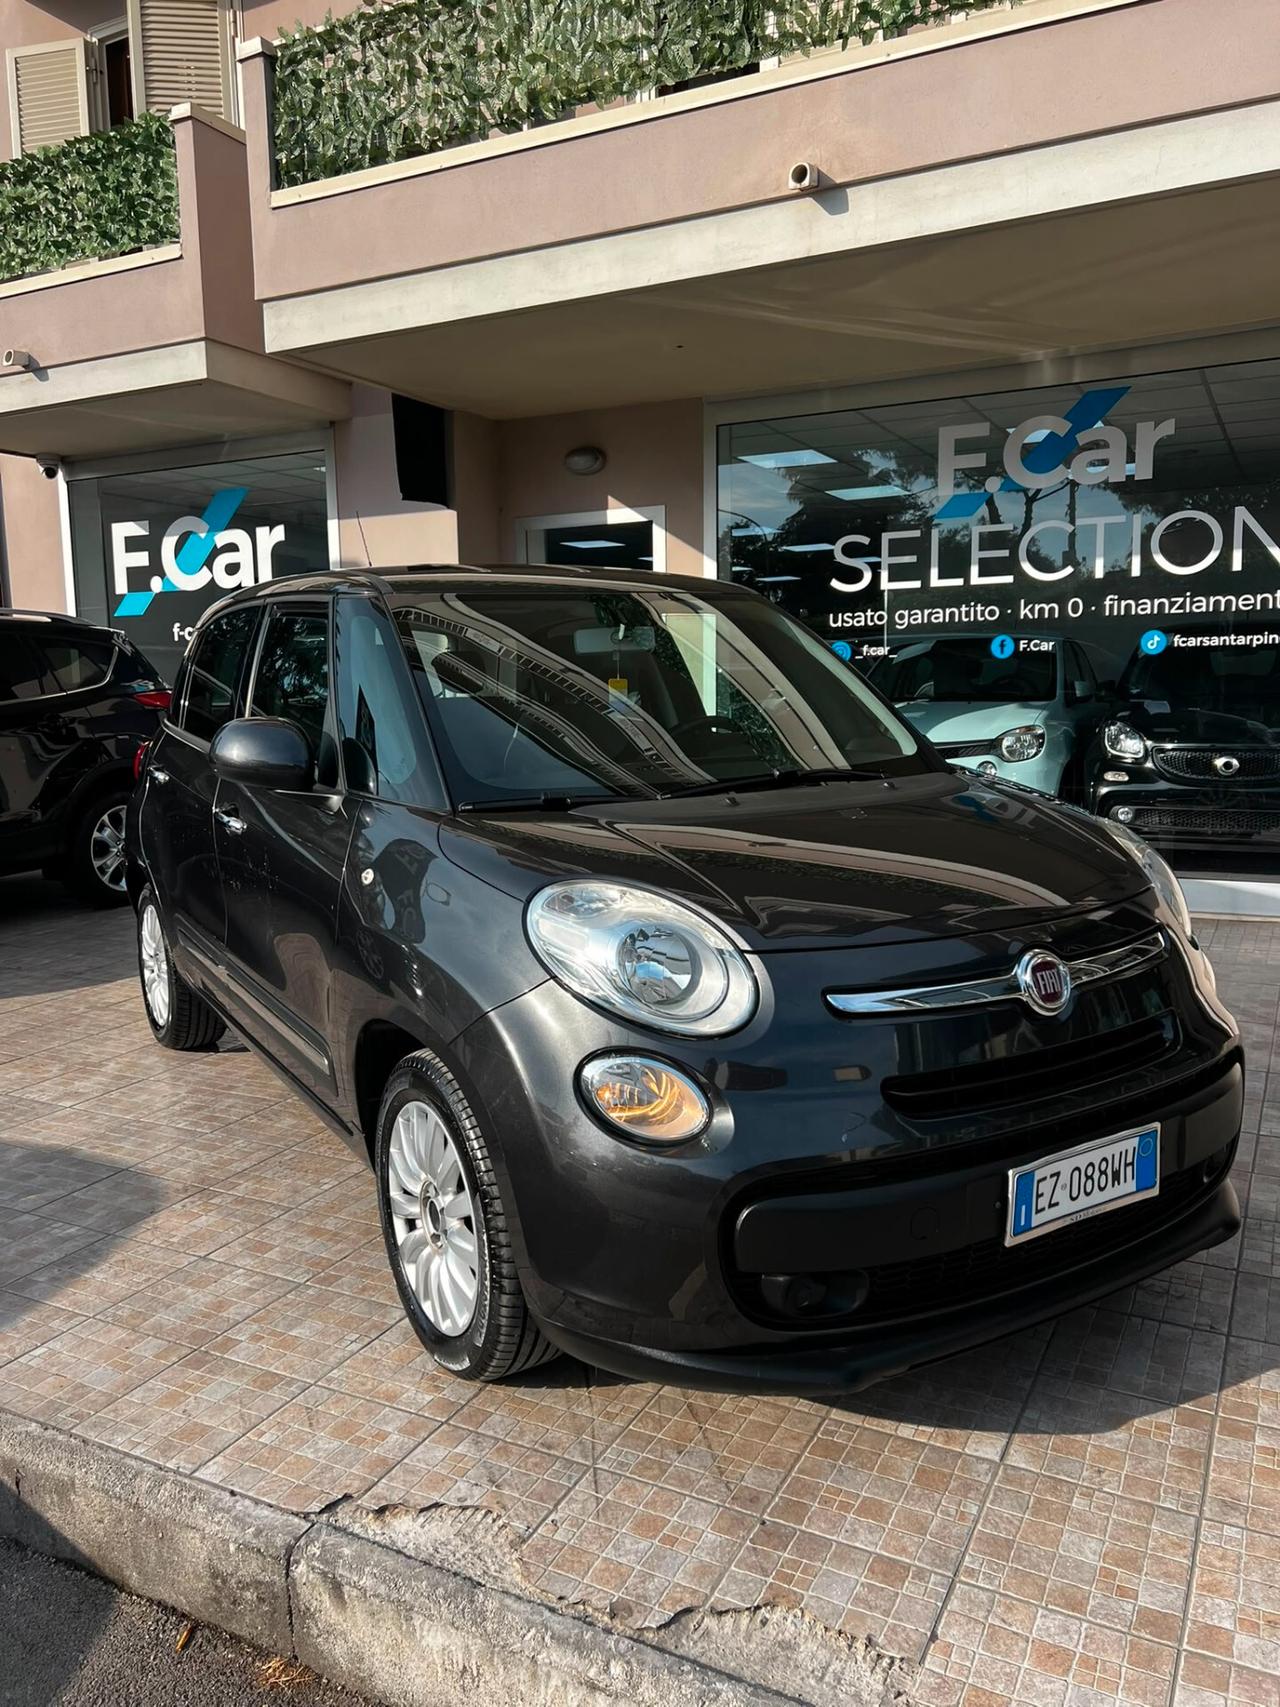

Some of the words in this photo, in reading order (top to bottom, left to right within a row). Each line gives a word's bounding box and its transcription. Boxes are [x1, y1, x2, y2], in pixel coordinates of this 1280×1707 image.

[938, 415, 1175, 496] F.Car
[111, 516, 286, 595] F.Car
[829, 506, 1280, 593] SELECTION
[829, 608, 888, 628] usato
[895, 602, 1000, 629] garantito
[1020, 599, 1059, 620] km
[1019, 640, 1055, 652] F.Car
[1173, 631, 1280, 647] fcarsantarpin
[1036, 968, 1062, 995] FIAT
